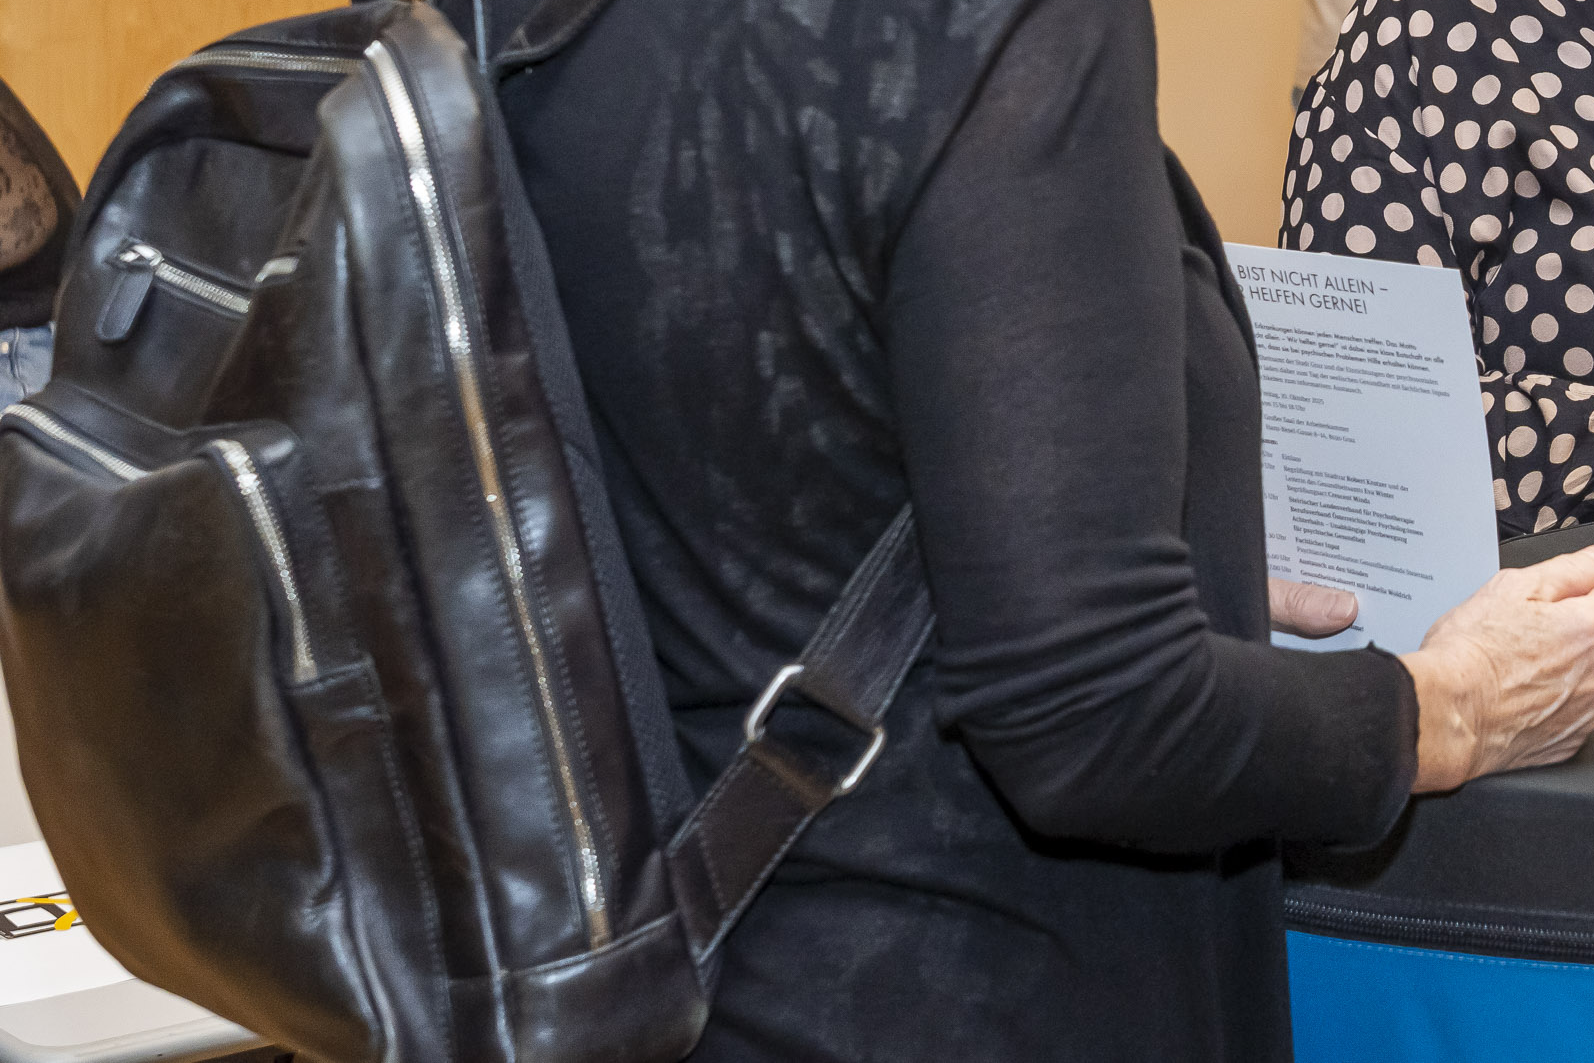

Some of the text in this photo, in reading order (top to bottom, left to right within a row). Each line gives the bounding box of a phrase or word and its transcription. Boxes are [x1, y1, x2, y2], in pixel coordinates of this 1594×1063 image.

[1237, 264, 1265, 282] BIST
[1271, 269, 1318, 288] NICHT
[1325, 275, 1376, 296] ALLEIN
[1249, 286, 1305, 306] HELFEN
[1254, 322, 1294, 335] Erkrankungen
[1294, 325, 1315, 336] können
[1333, 333, 1363, 343] Menschen
[1385, 339, 1398, 348] Das
[1301, 348, 1335, 358] psychischen
[1335, 352, 1367, 363] Problemen
[1395, 350, 1423, 361] Botschaft
[1364, 488, 1375, 496] Eva
[1290, 505, 1332, 518] Berufsverband
[1331, 511, 1378, 527] Österreichischer
[1372, 510, 1416, 525] Psychotherapie
[1299, 558, 1328, 568] Austausch
